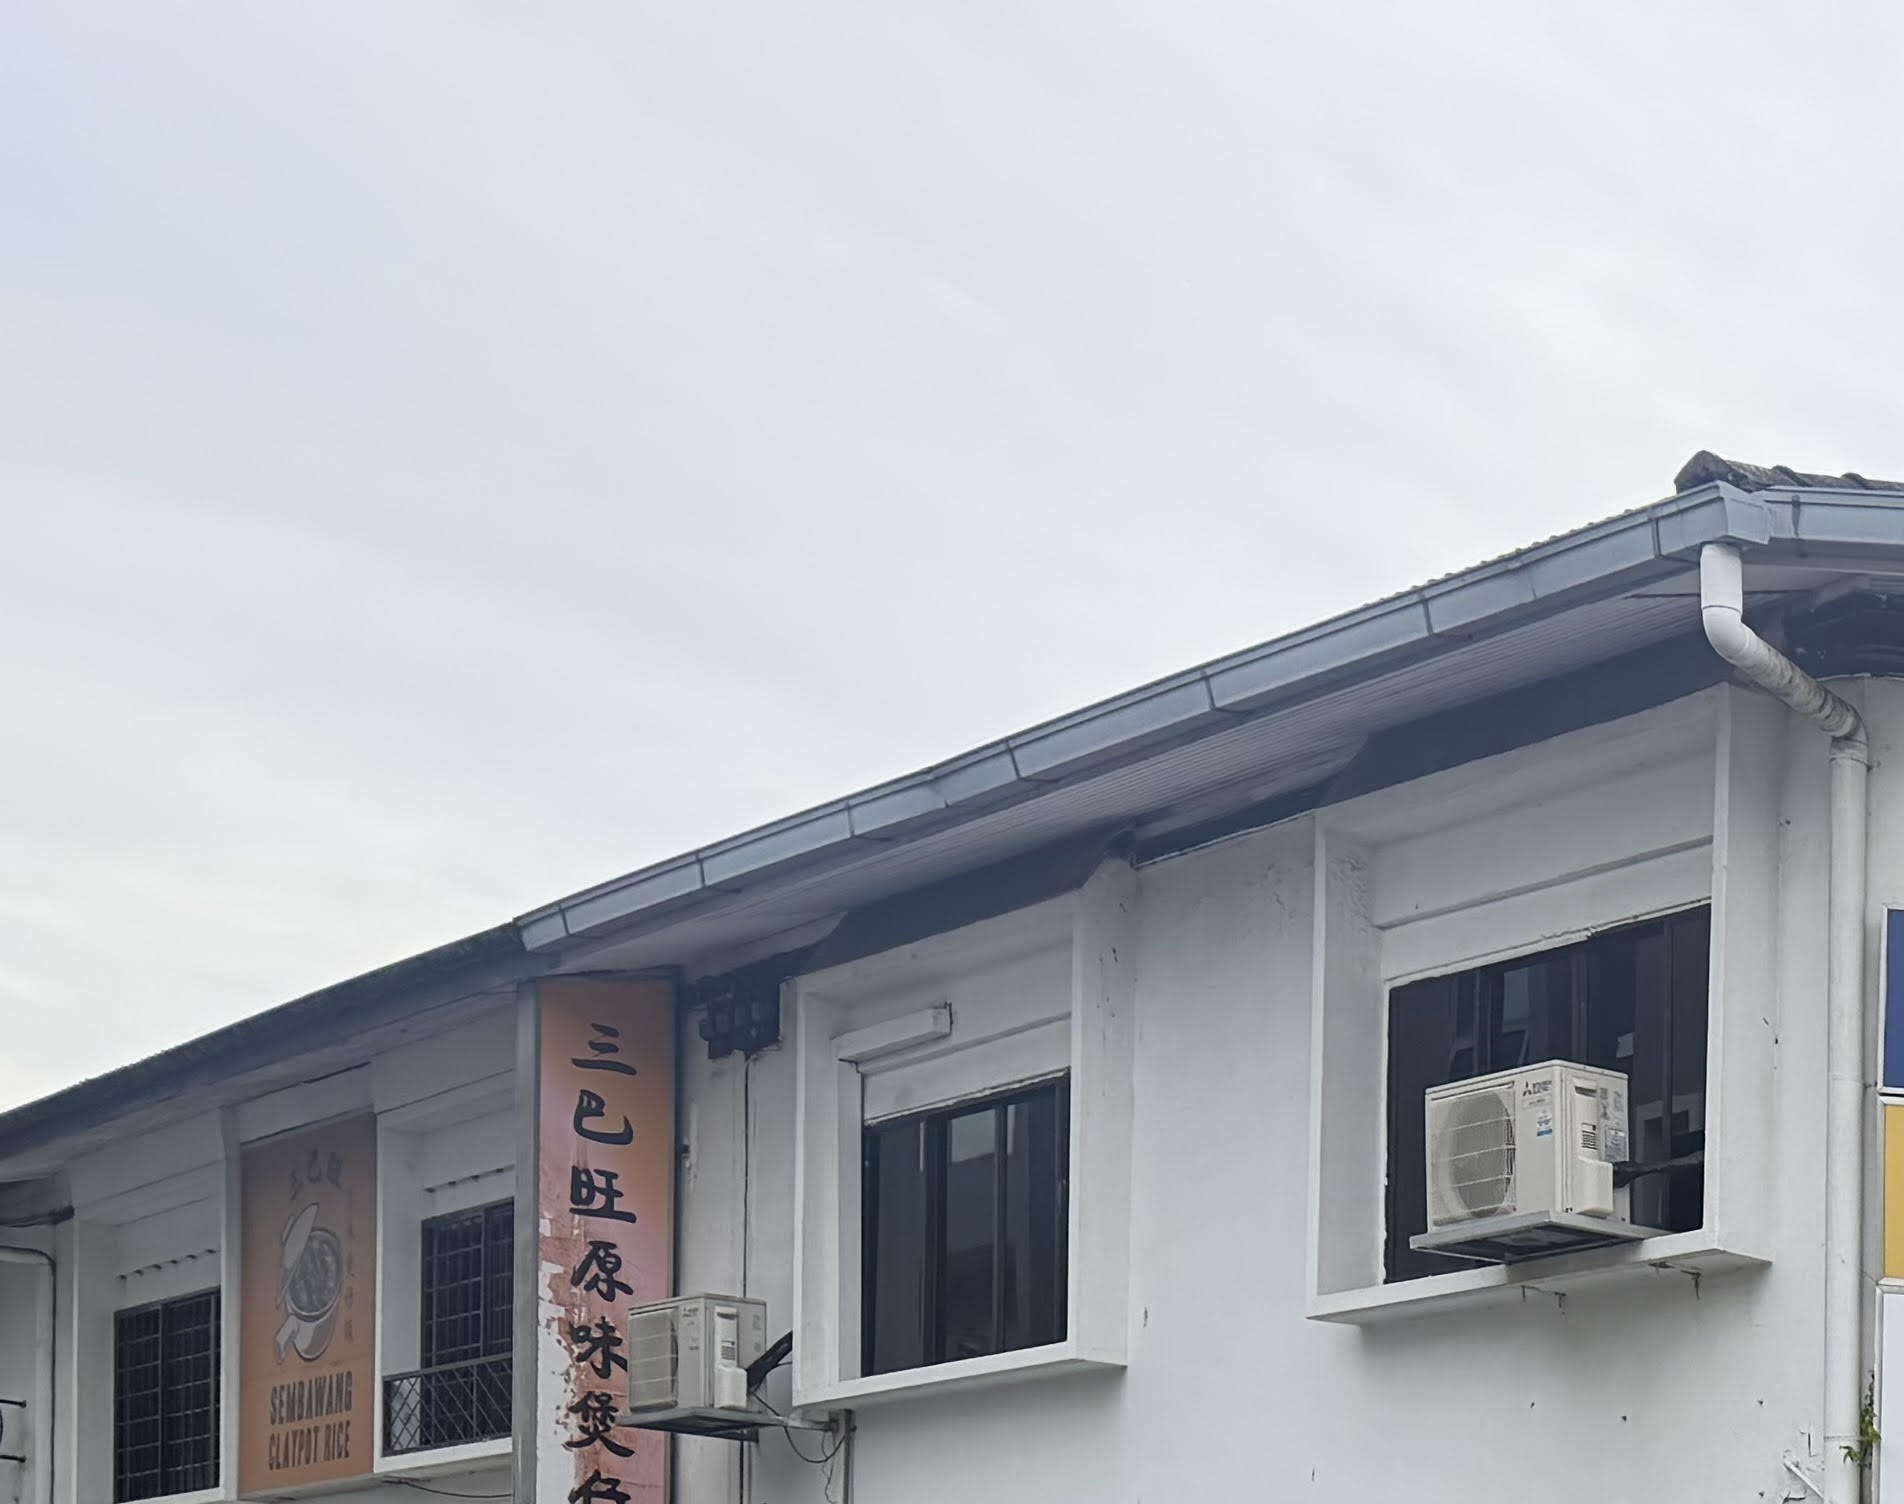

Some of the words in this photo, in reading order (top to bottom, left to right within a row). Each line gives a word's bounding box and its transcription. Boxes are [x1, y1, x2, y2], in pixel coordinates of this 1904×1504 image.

[270, 1370, 353, 1426] SEMBAWANG
[268, 1425, 320, 1471] CLAYPOT
[324, 1420, 351, 1462] RICE
